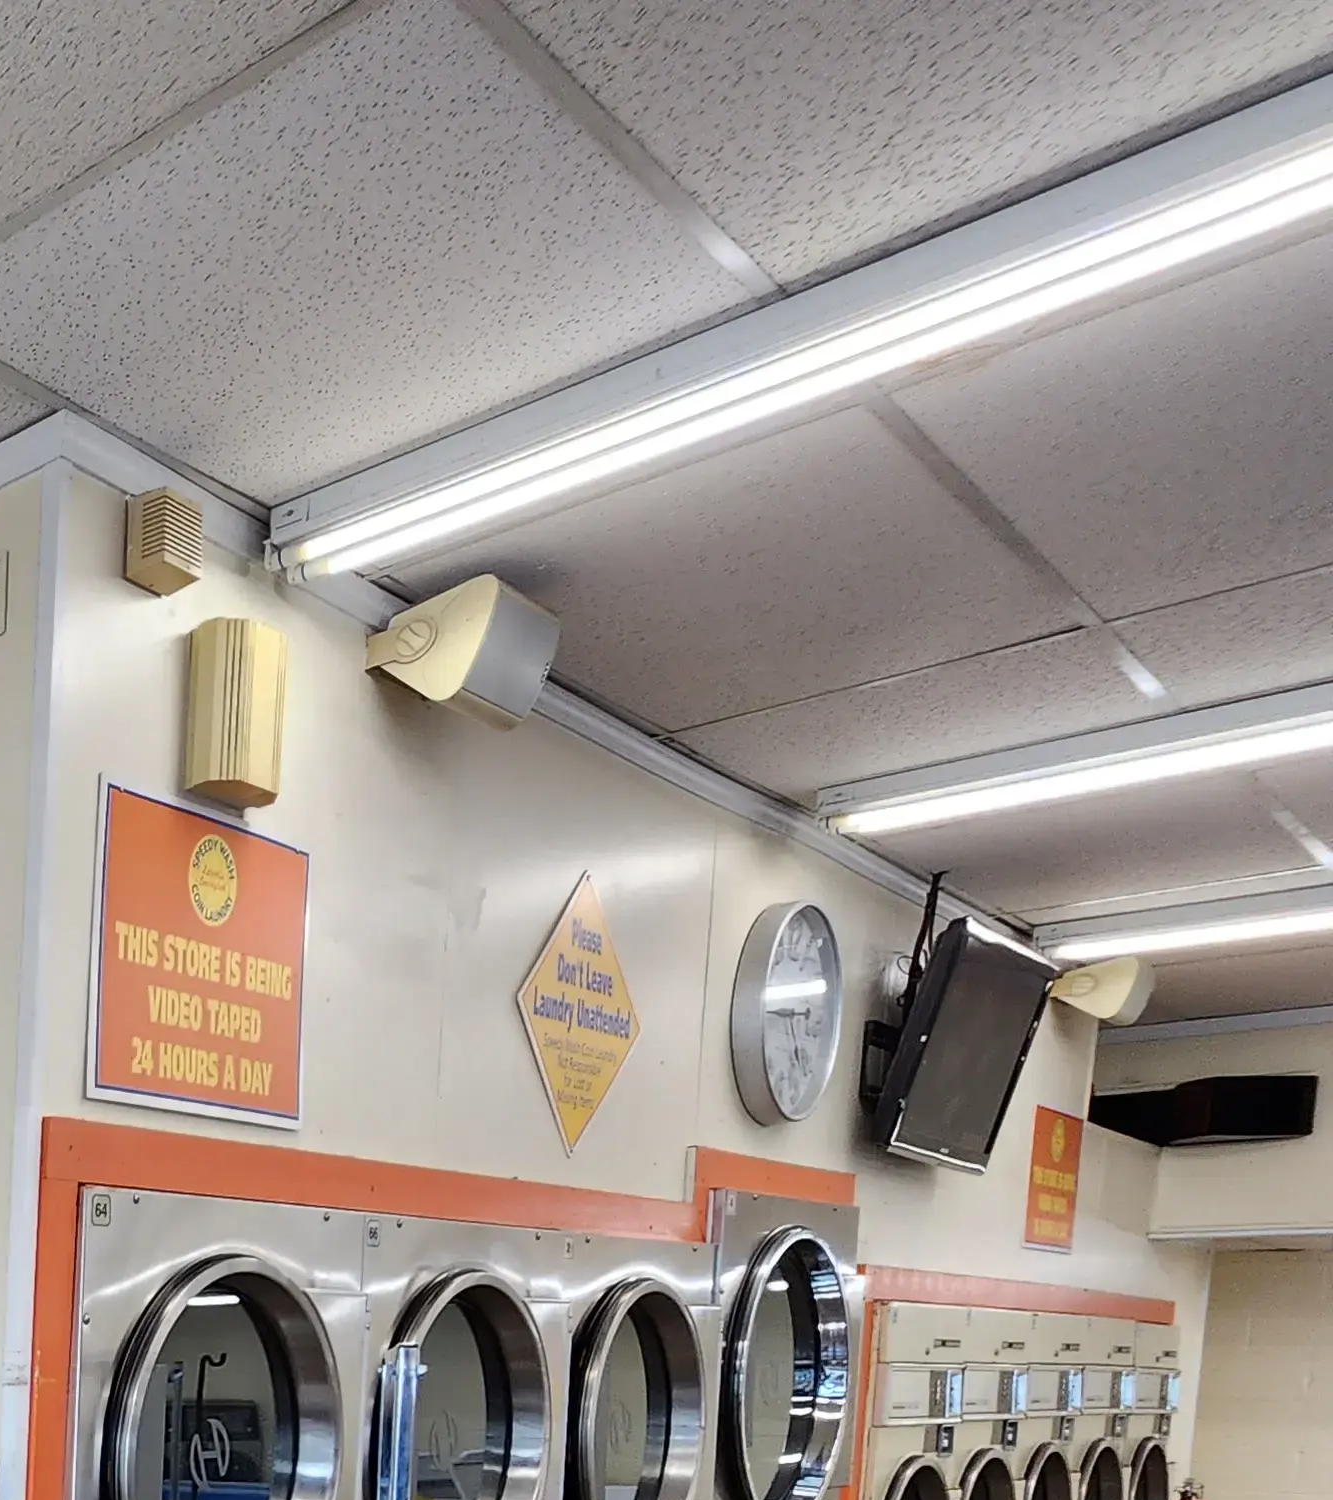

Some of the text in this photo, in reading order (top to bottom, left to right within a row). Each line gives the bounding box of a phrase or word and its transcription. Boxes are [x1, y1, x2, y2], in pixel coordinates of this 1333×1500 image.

[115, 920, 292, 1001] THIS STORE IS BEING
[572, 918, 602, 955] Please
[557, 952, 612, 998] Don't Leave
[147, 984, 261, 1043] VIDEO TAPED
[533, 985, 631, 1039] Laundry Unattended
[131, 1036, 273, 1096] 24 HOURS A DAY
[95, 1203, 107, 1218] 64
